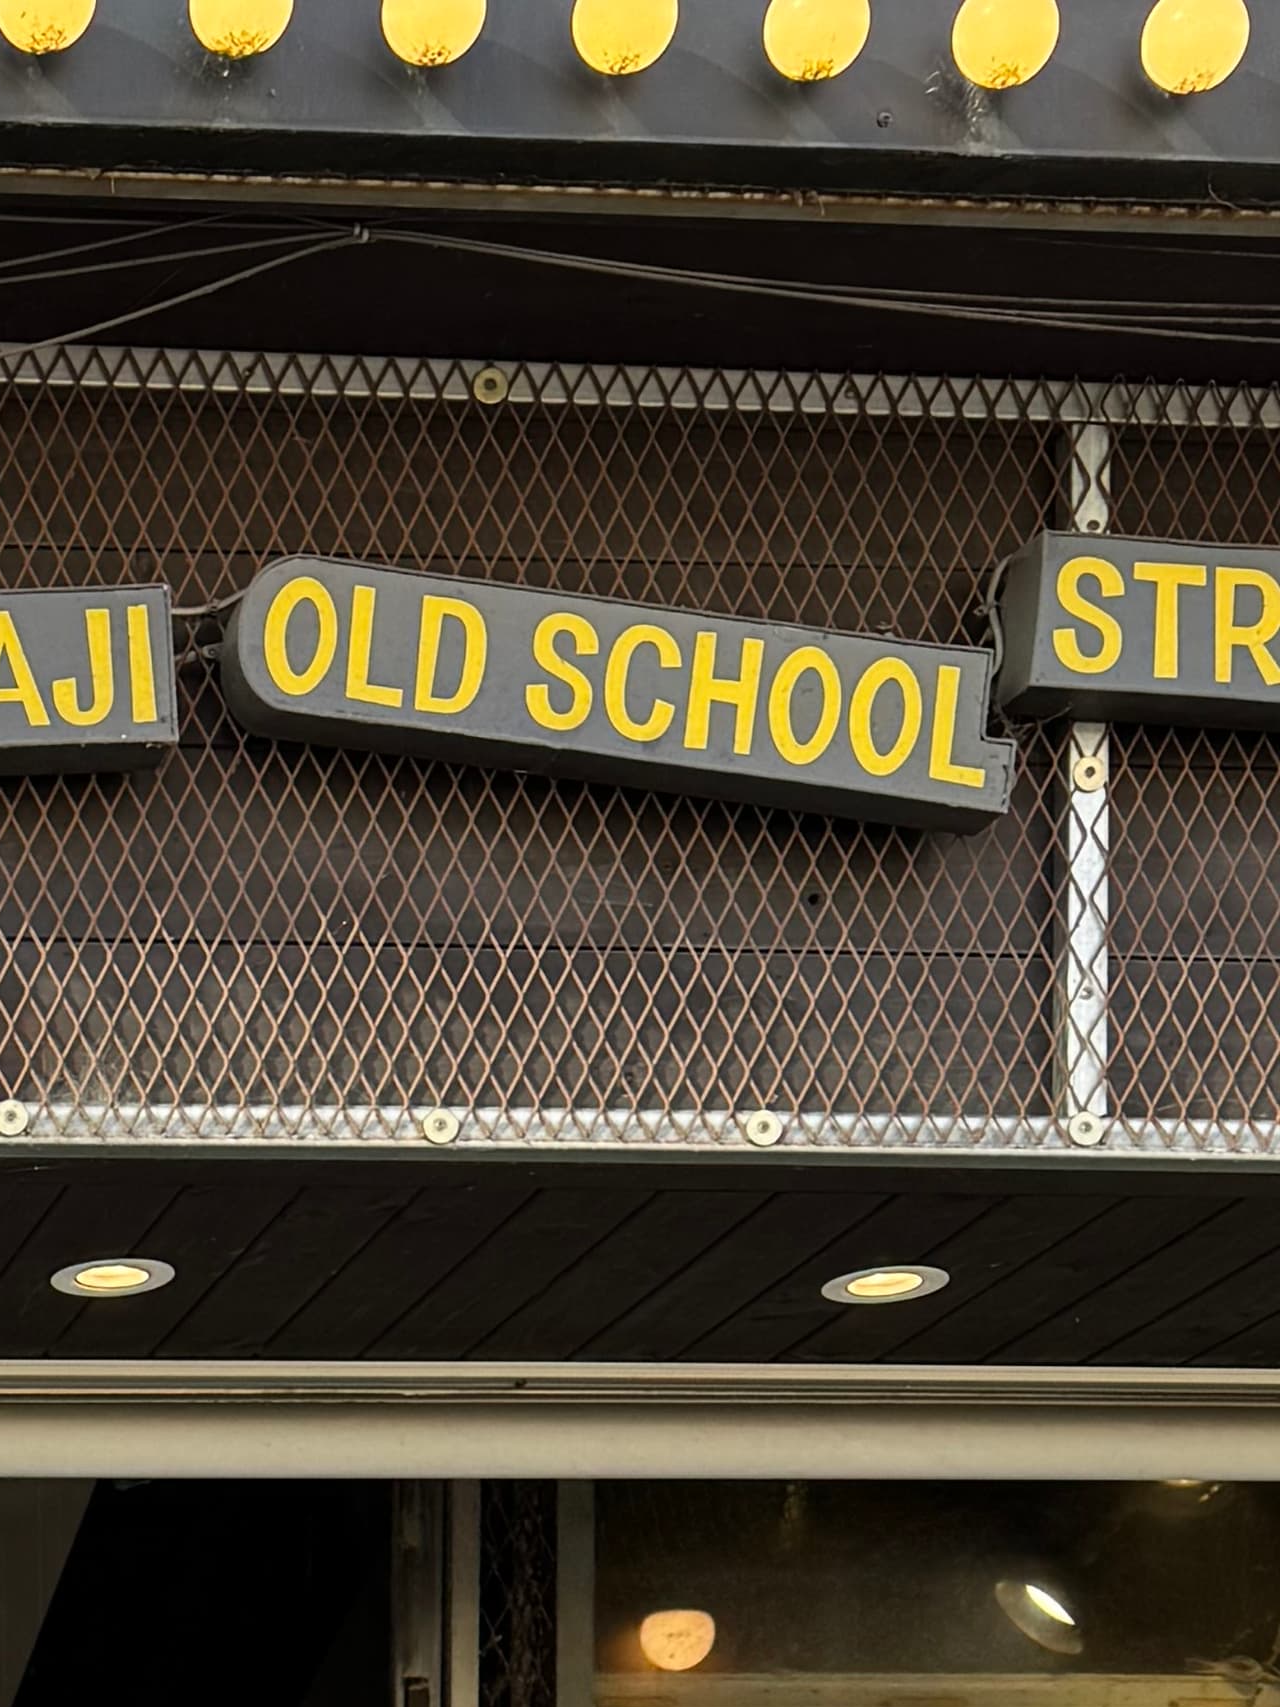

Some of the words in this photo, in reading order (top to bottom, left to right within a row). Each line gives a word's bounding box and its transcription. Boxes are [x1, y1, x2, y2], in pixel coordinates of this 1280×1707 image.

[264, 578, 485, 713] OLD
[526, 614, 983, 787] SCHOOL
[1053, 558, 1280, 684] STR
